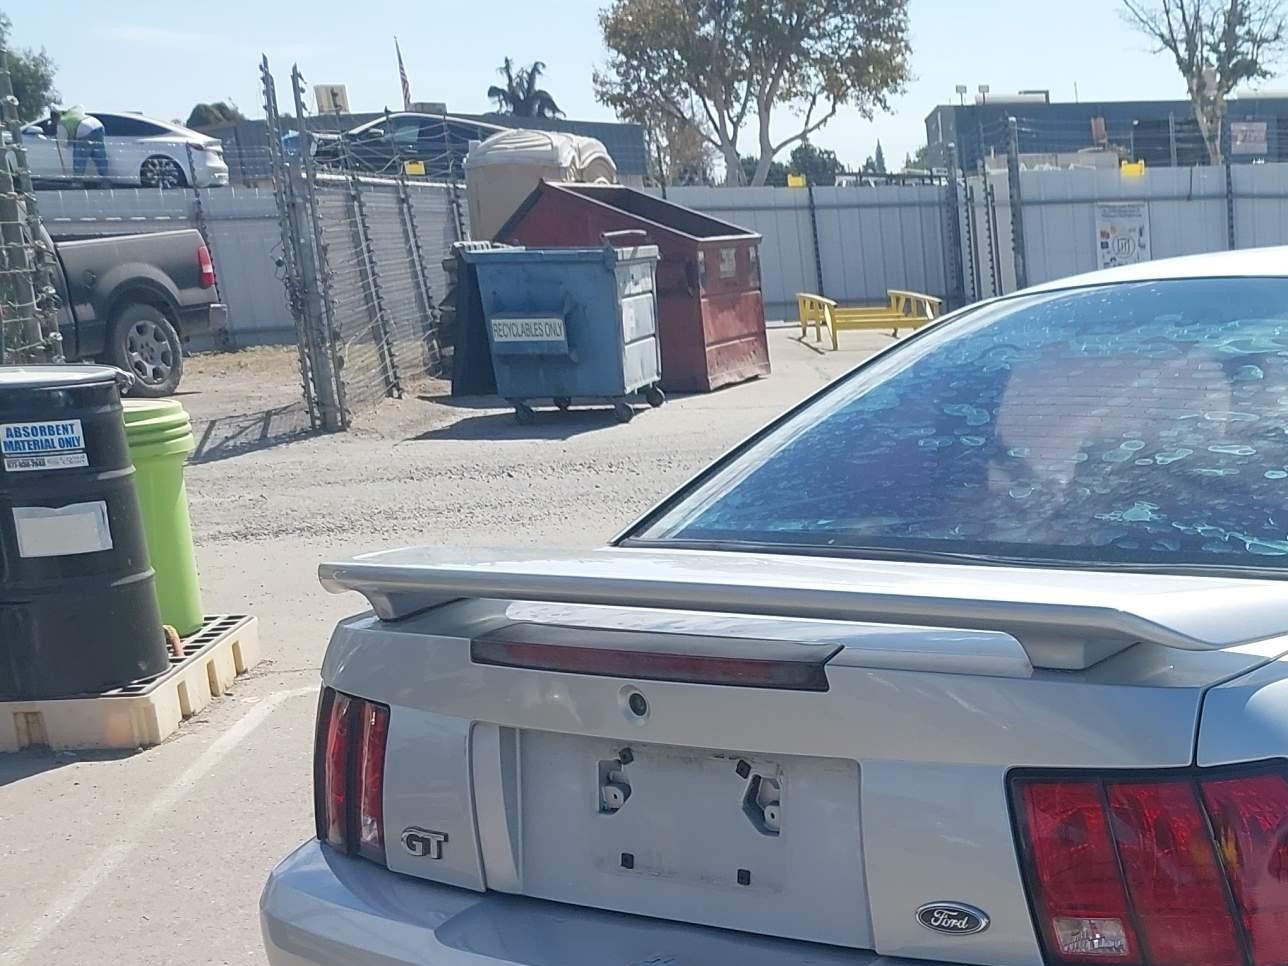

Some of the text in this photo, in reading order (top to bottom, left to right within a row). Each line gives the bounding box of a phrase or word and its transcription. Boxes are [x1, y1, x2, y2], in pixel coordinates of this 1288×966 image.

[493, 322, 563, 337] RECYCLABLES ONLY
[5, 424, 75, 438] ABSORBENT
[3, 436, 81, 451] MATERIAL ONLY
[401, 826, 449, 860] GT
[930, 909, 969, 929] Ford
